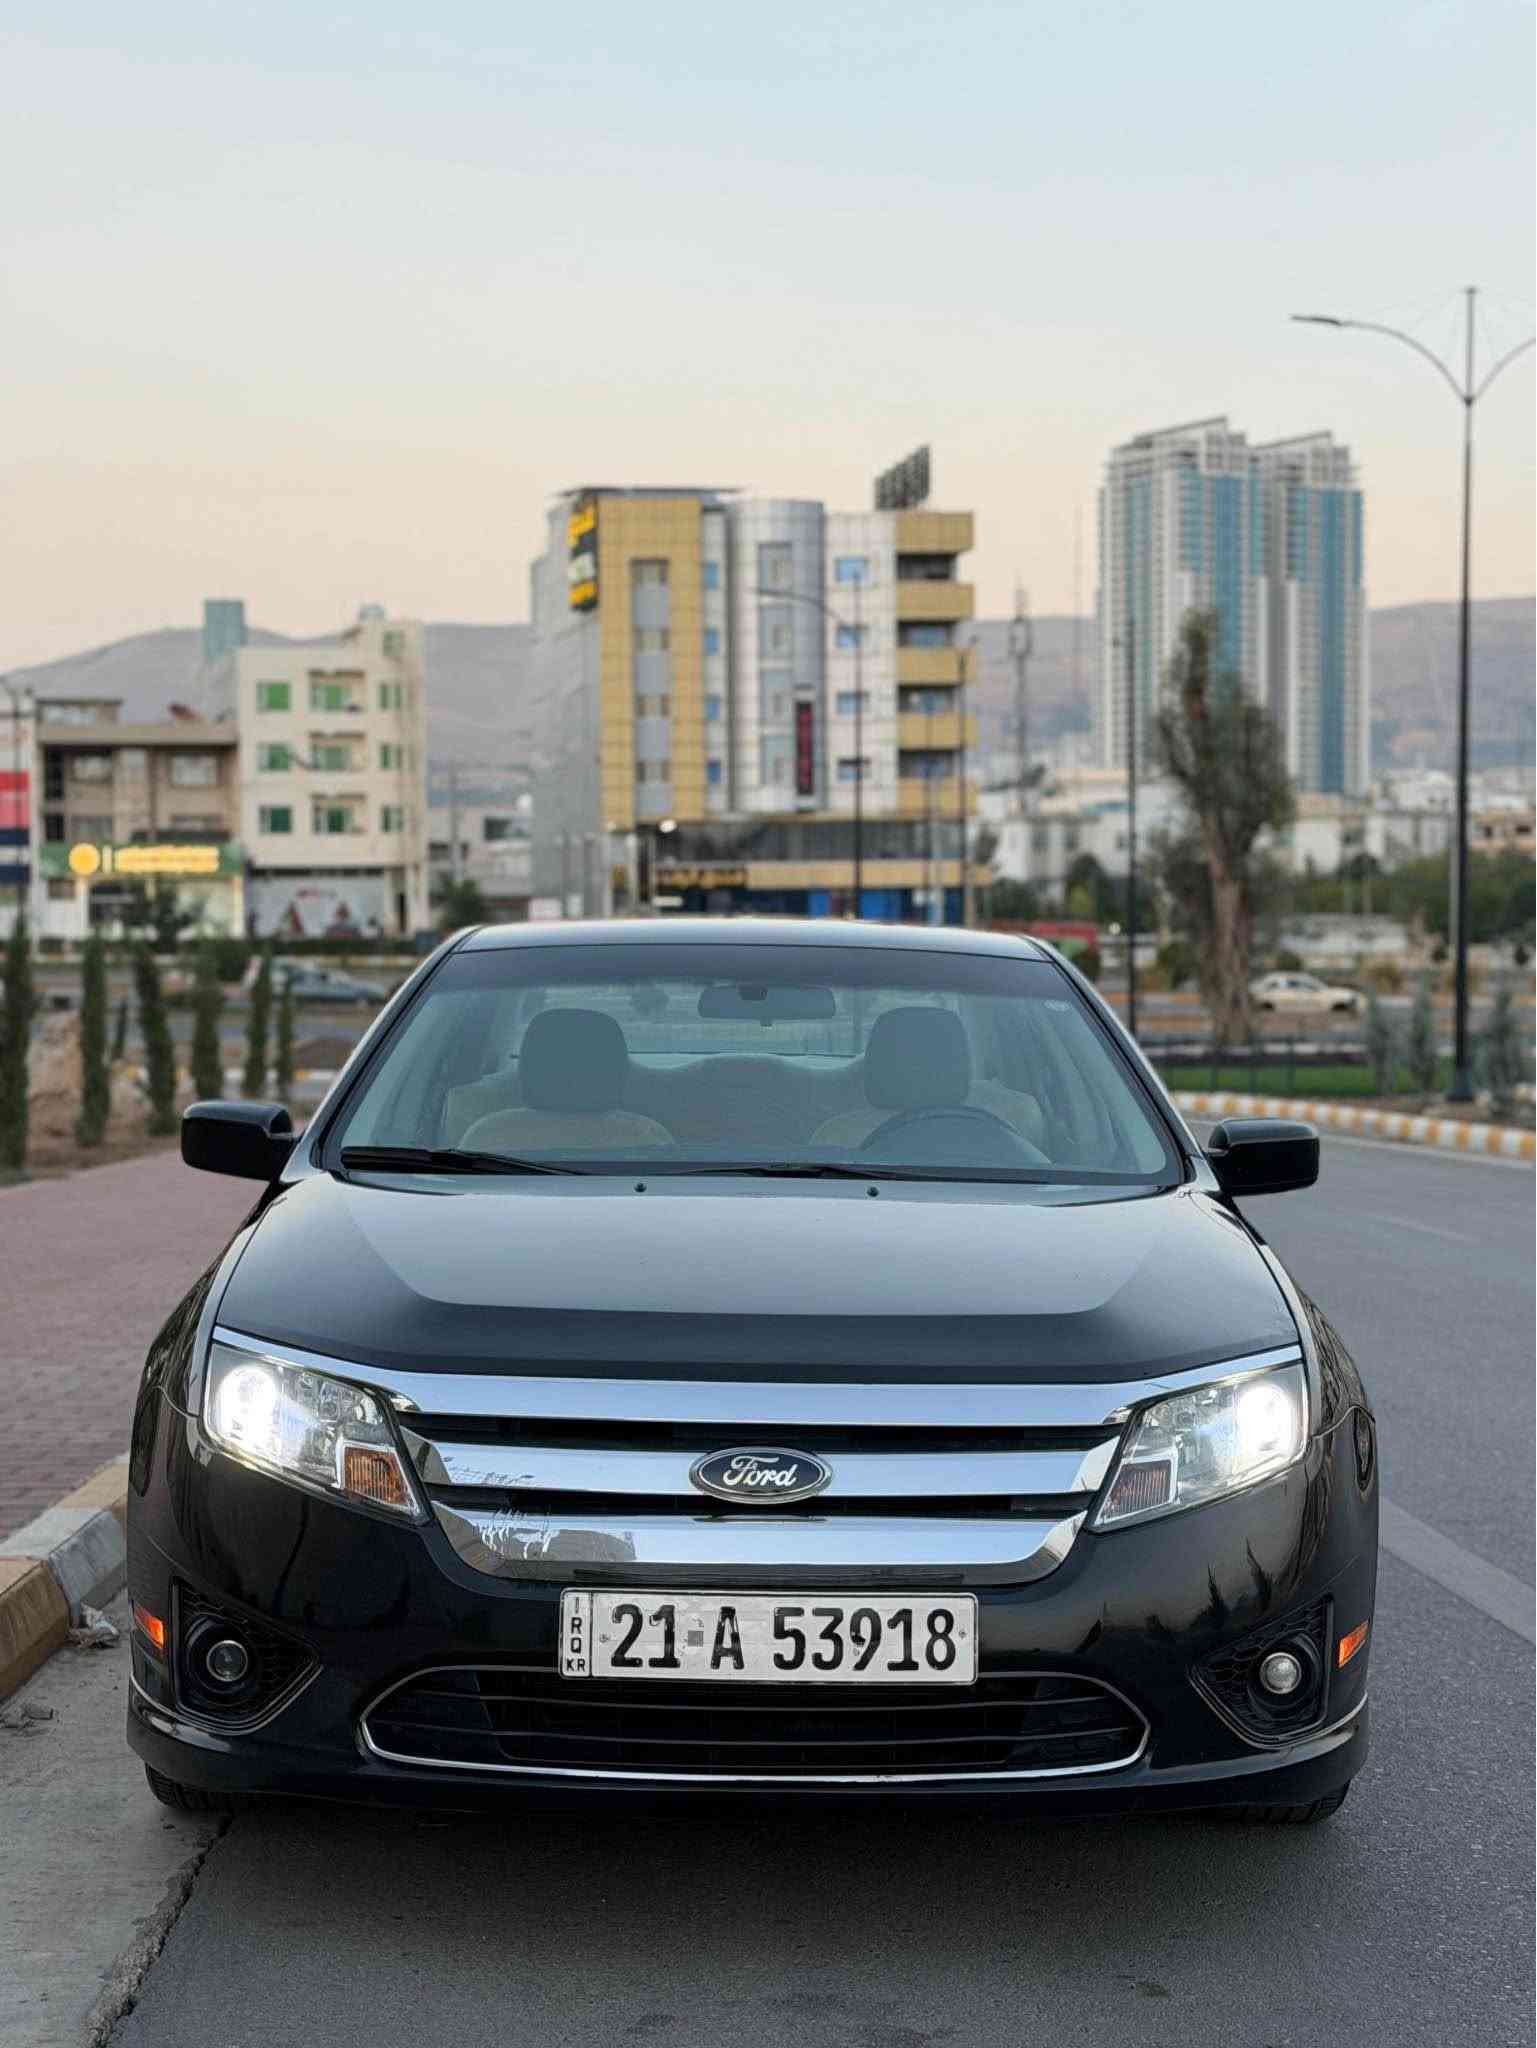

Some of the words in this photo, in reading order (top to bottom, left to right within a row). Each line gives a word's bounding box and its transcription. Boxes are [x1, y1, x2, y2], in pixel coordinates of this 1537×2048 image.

[722, 1455, 799, 1487] Ford
[610, 1603, 681, 1669] 21
[709, 1605, 745, 1671] A
[772, 1606, 957, 1672] 53918
[566, 1658, 586, 1673] KR
